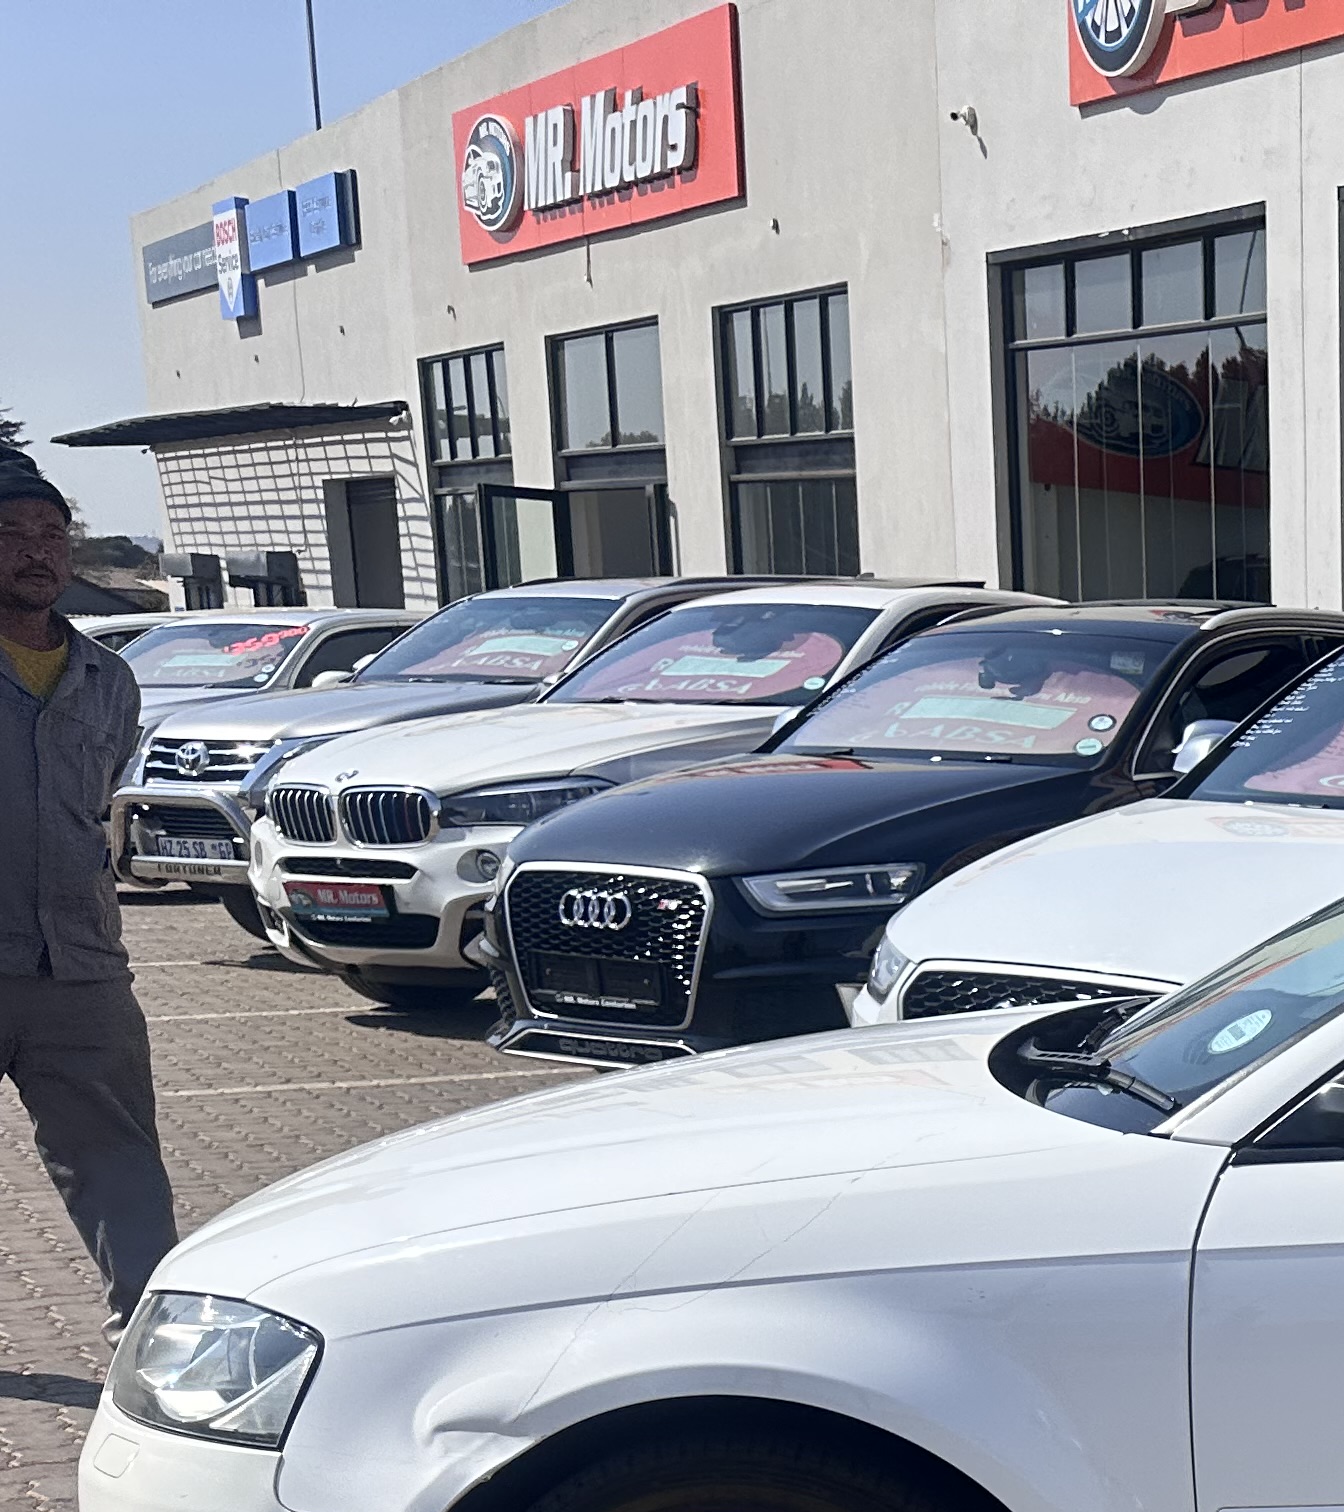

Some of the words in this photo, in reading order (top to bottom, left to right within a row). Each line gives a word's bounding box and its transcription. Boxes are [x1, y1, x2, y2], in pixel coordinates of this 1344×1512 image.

[524, 104, 572, 211] MR.
[579, 85, 688, 196] Motors
[339, 890, 379, 905] Motors
